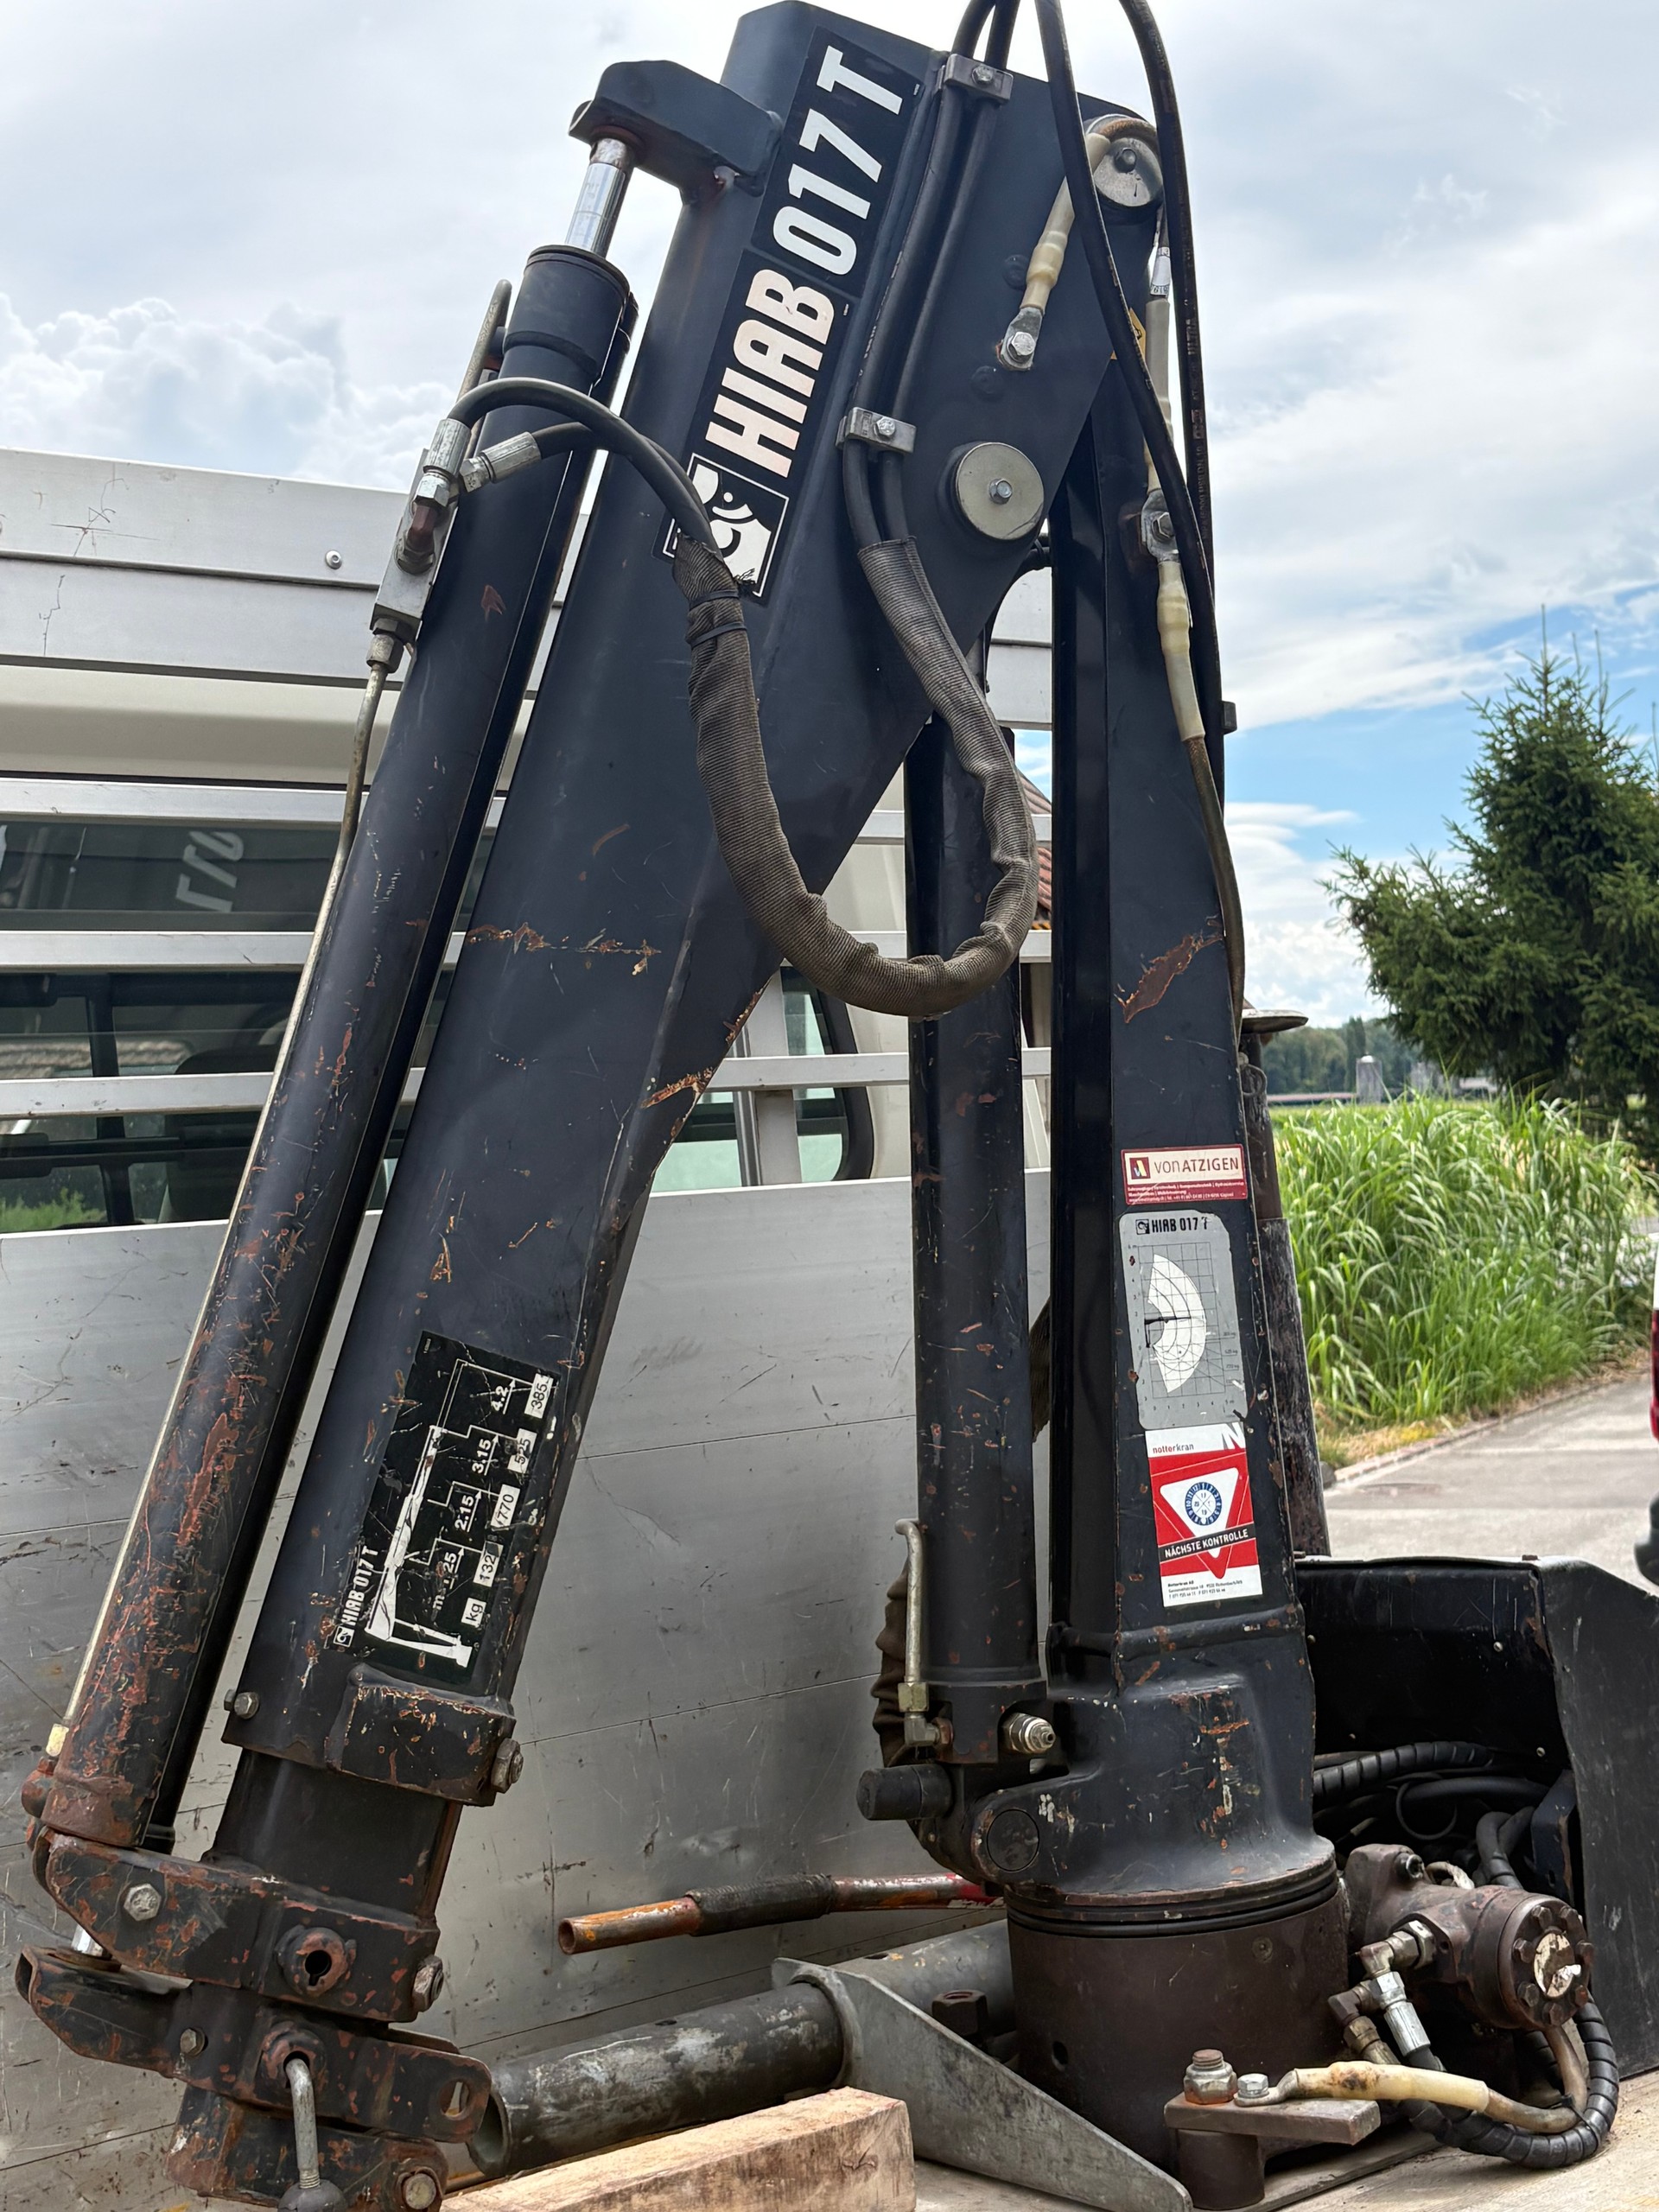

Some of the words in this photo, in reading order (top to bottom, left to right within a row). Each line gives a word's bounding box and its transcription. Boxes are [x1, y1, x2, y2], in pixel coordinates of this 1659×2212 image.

[816, 45, 903, 115] T
[772, 108, 882, 276] 017
[705, 269, 835, 478] HIAB
[1152, 1218, 1177, 1233] HIAB
[1180, 1217, 1199, 1231] 017
[454, 1495, 474, 1531] 2.15
[472, 1439, 492, 1474] 3.15
[492, 1385, 508, 1412] 4.2
[1152, 1443, 1195, 1454] notterkran
[465, 1604, 484, 1622] kg
[480, 1553, 498, 1581] 132
[531, 1383, 548, 1410] 385
[361, 1545, 378, 1556] T
[1165, 1540, 1202, 1558] NÄCHSTE
[1202, 1529, 1249, 1549] KONTROLLE
[353, 1558, 374, 1587] 017
[340, 1590, 365, 1626] HIAB
